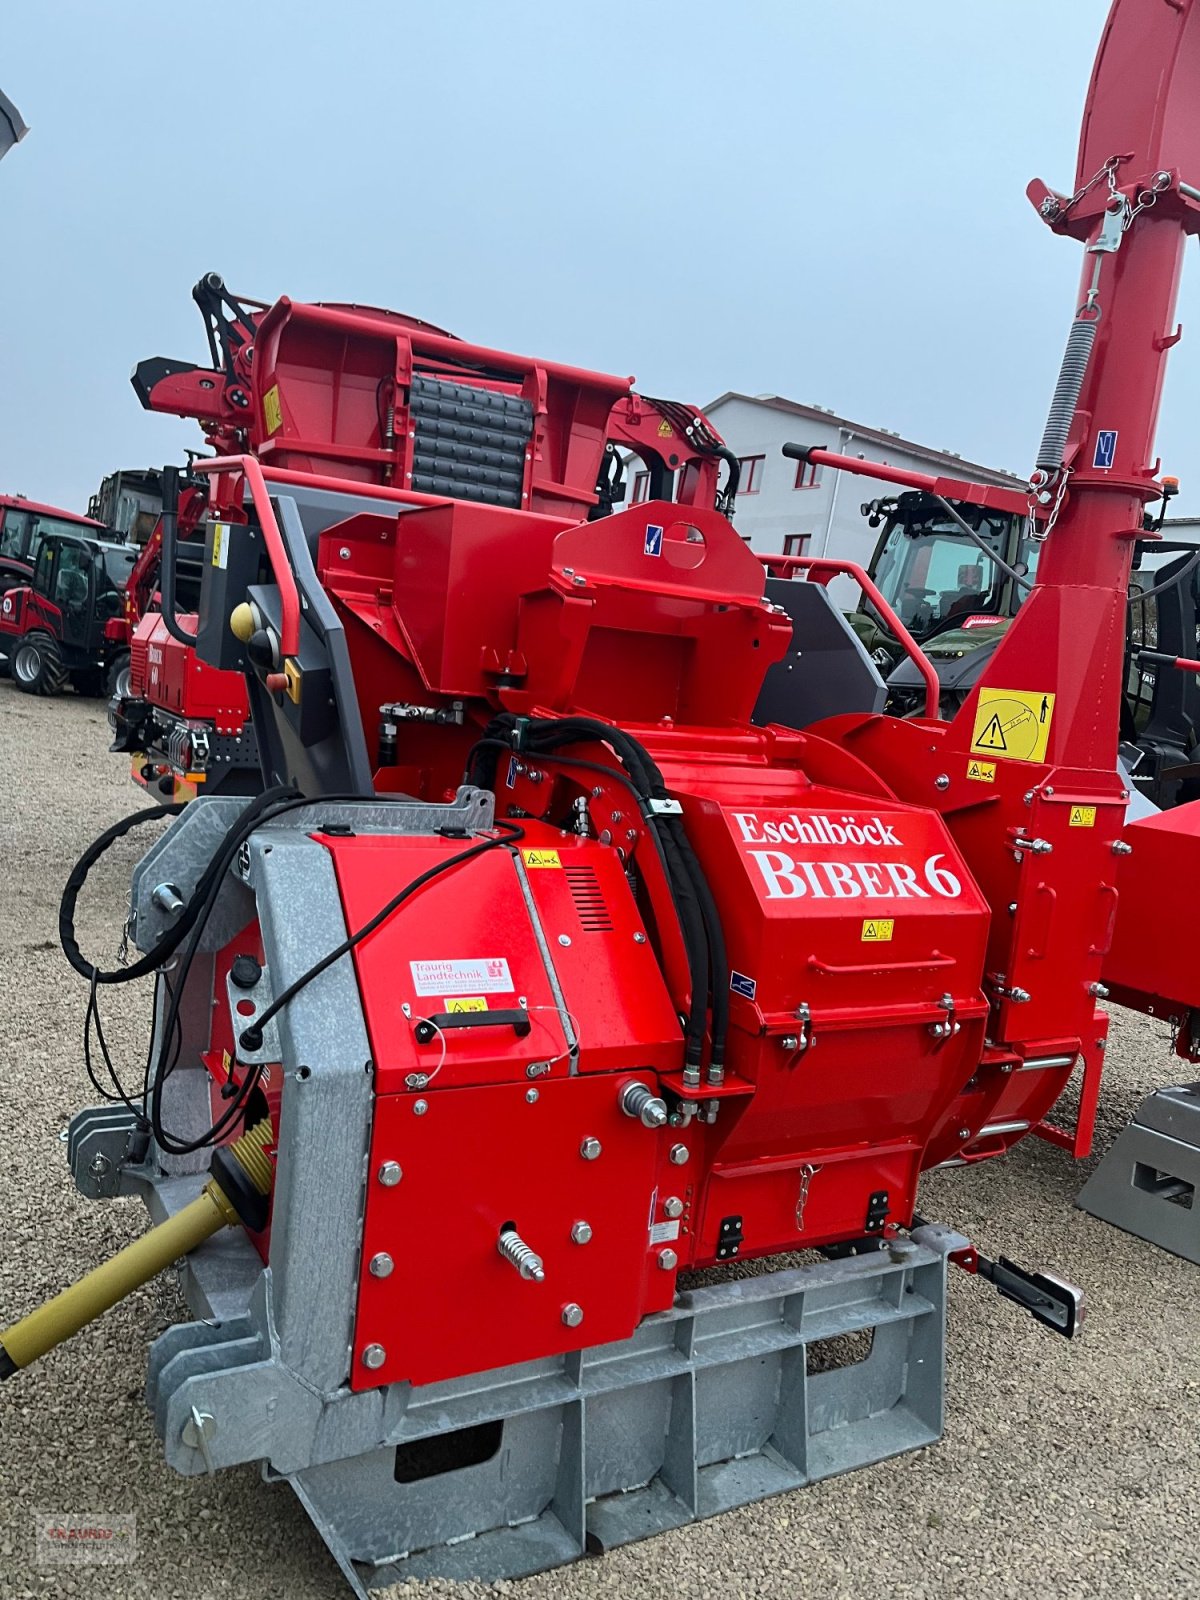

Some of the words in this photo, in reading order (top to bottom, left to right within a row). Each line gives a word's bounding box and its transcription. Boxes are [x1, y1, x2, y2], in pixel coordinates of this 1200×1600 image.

[731, 812, 904, 846] Eschlböck
[746, 849, 932, 899] BIBER
[924, 853, 962, 898] 6
[415, 962, 453, 972] Traurig
[417, 970, 482, 981] Landtechnik
